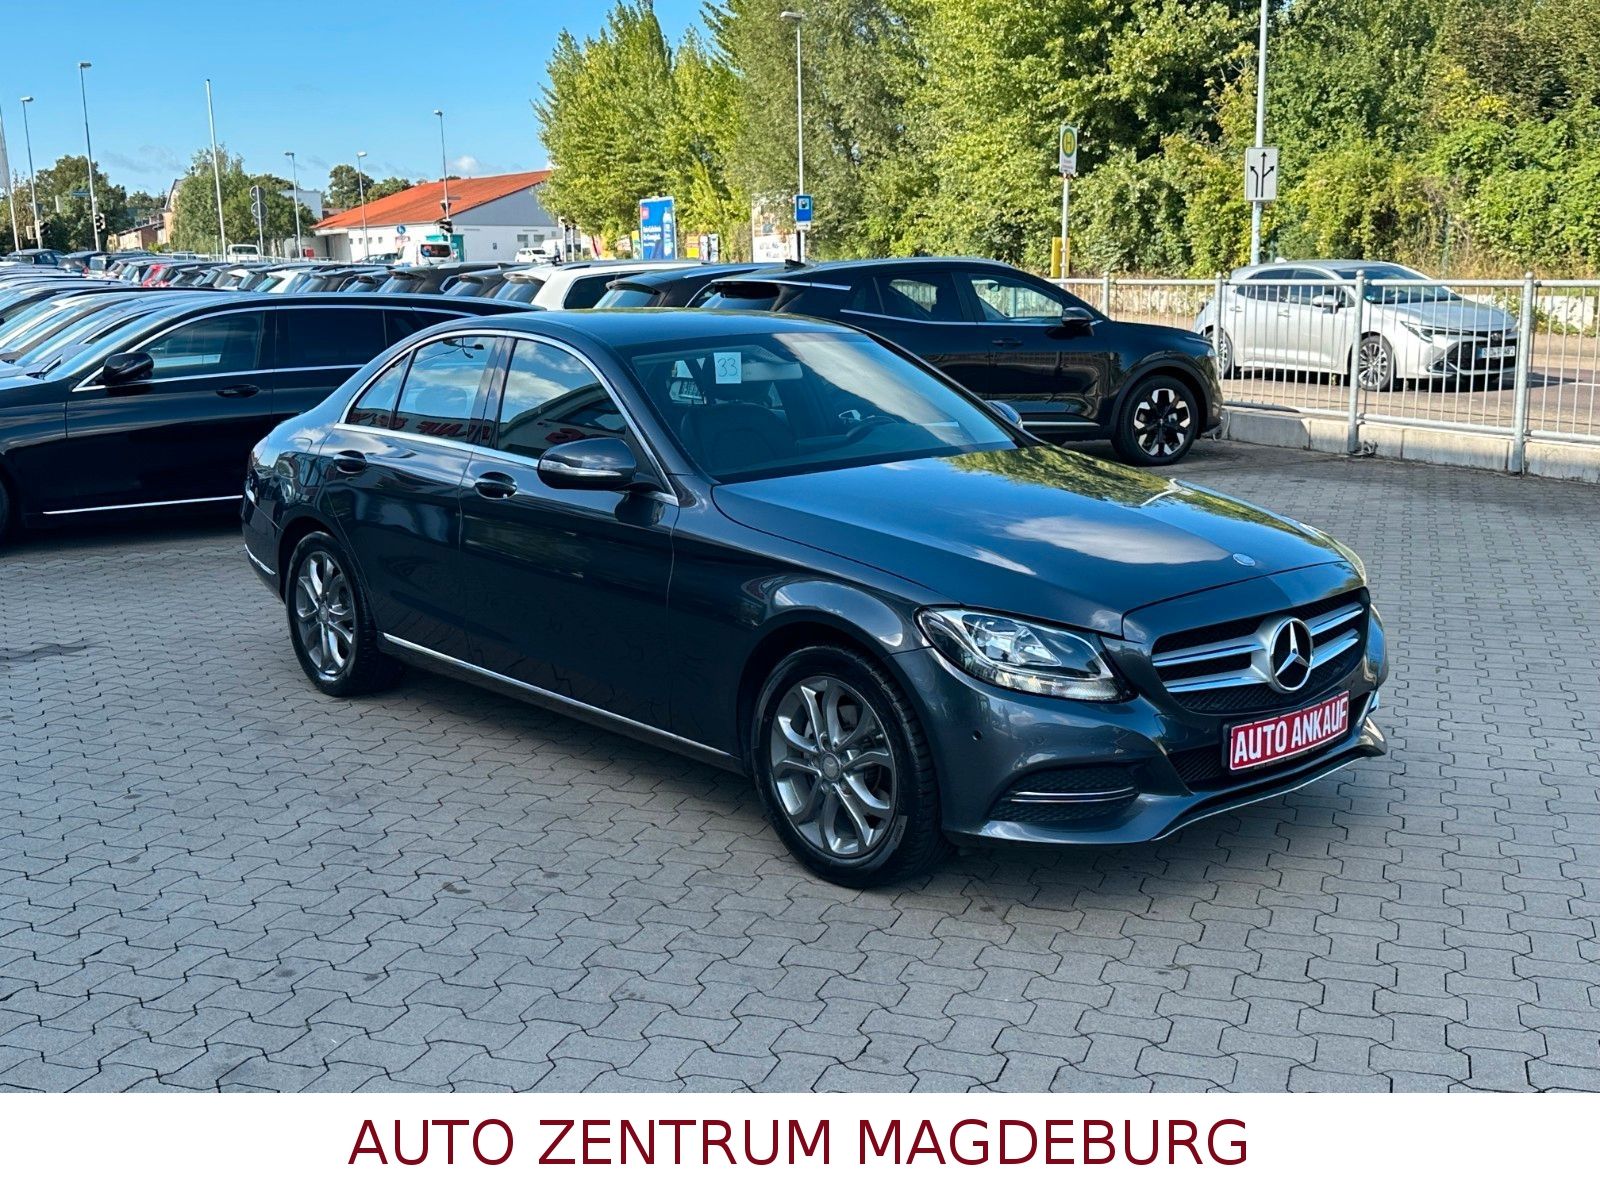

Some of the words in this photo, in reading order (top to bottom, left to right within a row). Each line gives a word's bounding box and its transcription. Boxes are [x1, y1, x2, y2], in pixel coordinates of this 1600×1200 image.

[717, 358, 738, 377] 33
[1234, 720, 1287, 764] AUTO
[1291, 697, 1348, 749] ANKAUF
